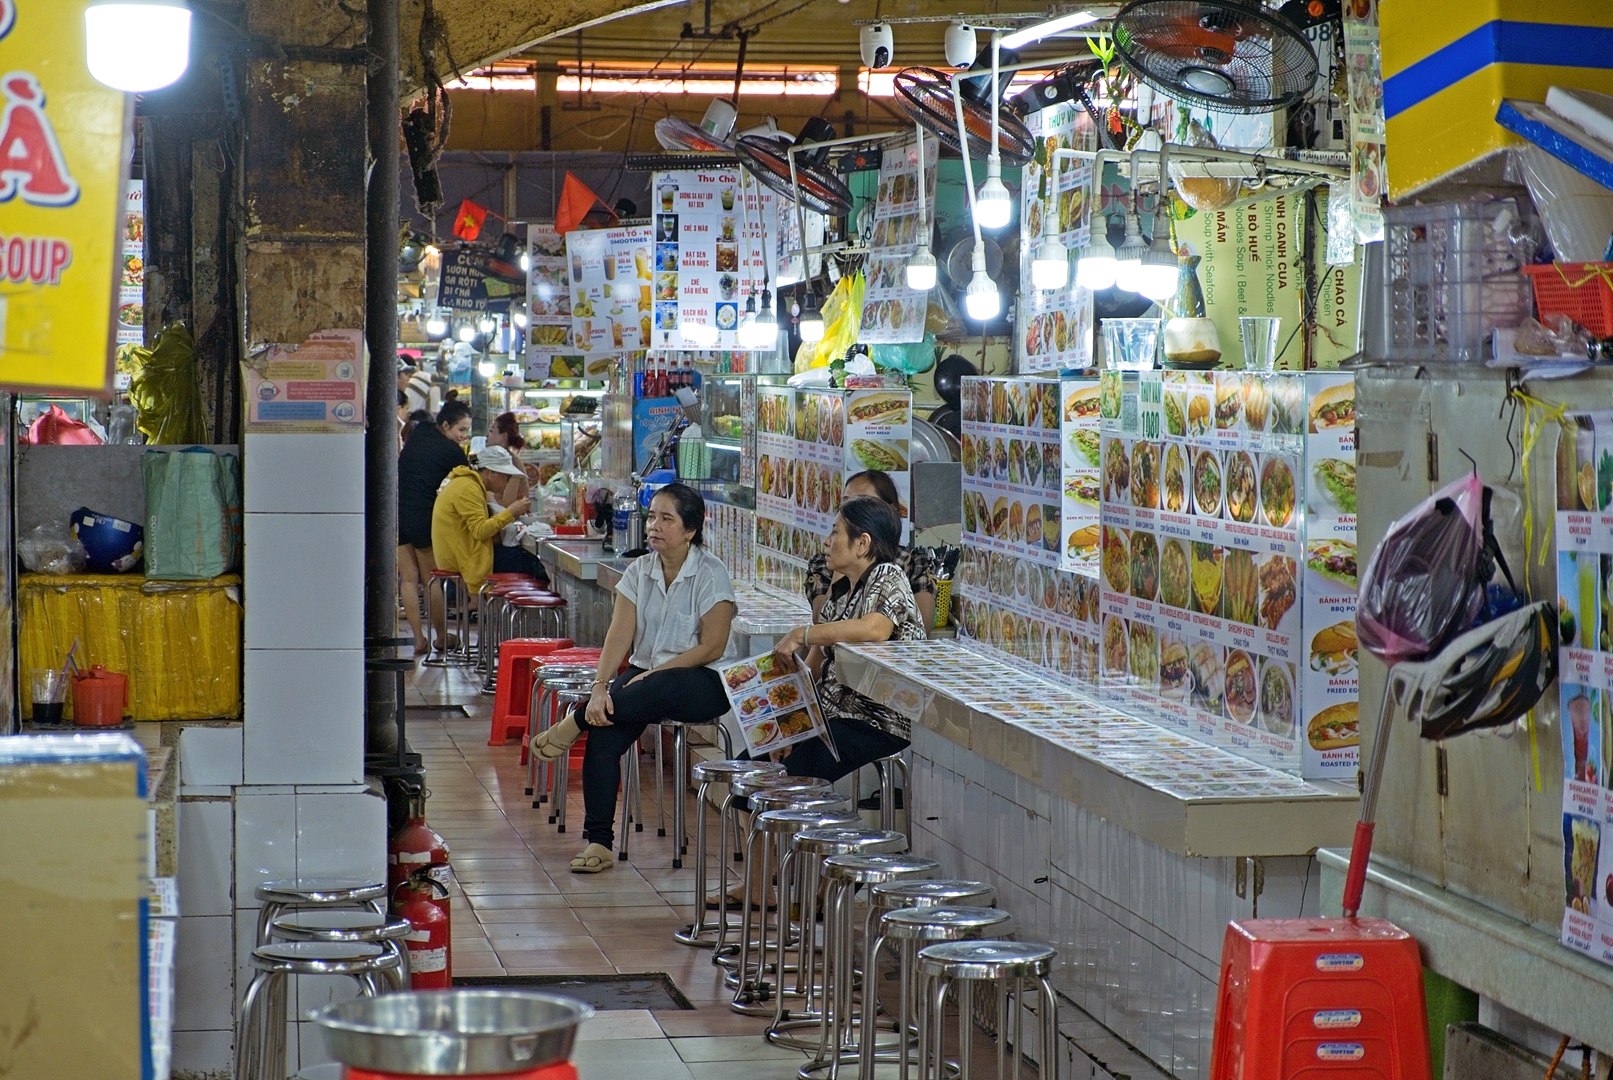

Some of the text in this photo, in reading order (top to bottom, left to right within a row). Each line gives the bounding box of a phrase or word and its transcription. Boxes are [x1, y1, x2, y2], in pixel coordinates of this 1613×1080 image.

[697, 174, 737, 182] Thu Chè
[1248, 214, 1260, 231] BÒ
[606, 231, 625, 239] SINH
[610, 237, 648, 245] SMOOTHIES
[0, 235, 71, 284] OUP
[1203, 212, 1216, 306] Soup with Seafood
[1235, 246, 1246, 271] Soup
[1264, 206, 1276, 313] Shrimp Thick Noodles
[1277, 222, 1288, 289] CANH CUA
[1238, 280, 1248, 304] Beef
[1323, 276, 1333, 316] Chicken
[1335, 269, 1348, 327] CHÁO CÁ
[456, 298, 473, 307] KHO
[649, 406, 670, 416] RINH
[1339, 435, 1355, 443] BÁN
[1319, 596, 1353, 604] BÁNH MÌ
[1228, 623, 1255, 638] SHRIMP PASTE
[1266, 632, 1290, 646] GRILLED MEAT
[1267, 645, 1275, 656] THỊT
[1329, 677, 1350, 686] BÁNH
[1224, 721, 1232, 731] BEEF
[1344, 751, 1354, 759] MÌ
